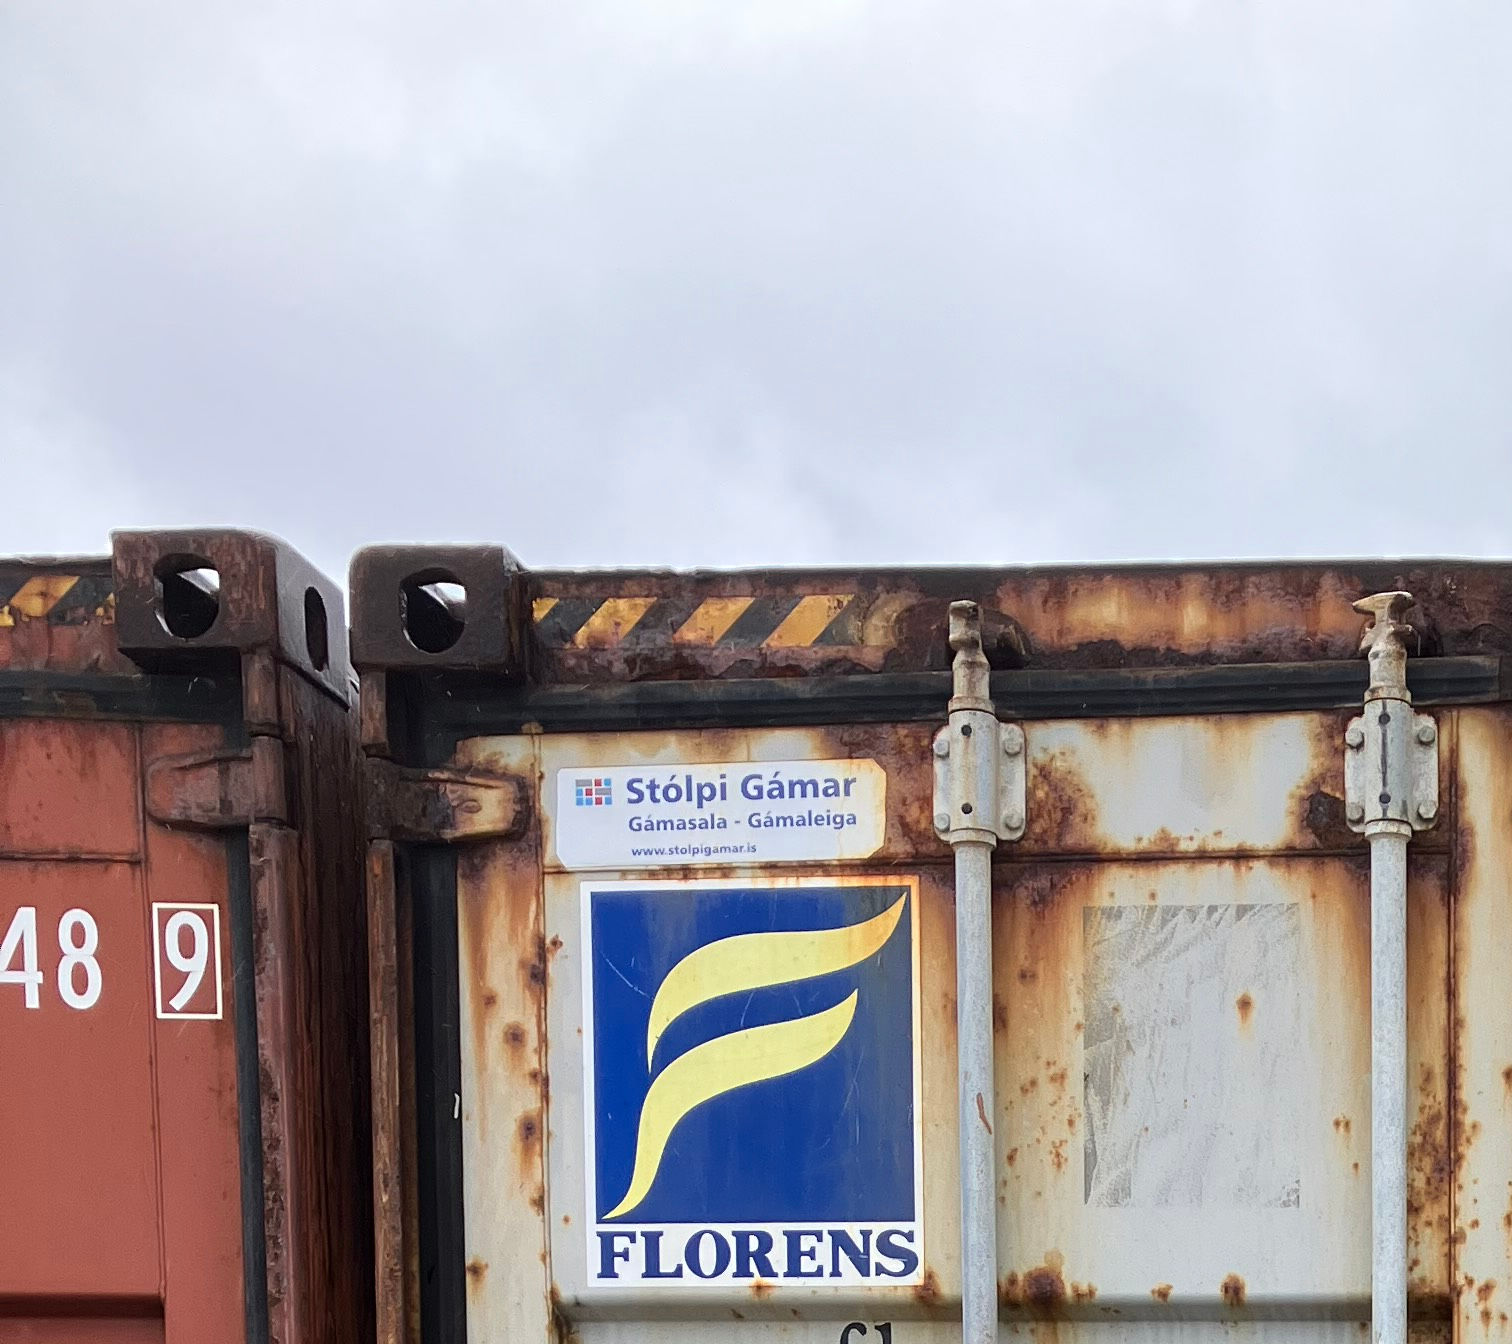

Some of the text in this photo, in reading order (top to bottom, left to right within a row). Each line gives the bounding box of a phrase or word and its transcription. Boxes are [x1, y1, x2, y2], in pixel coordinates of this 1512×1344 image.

[626, 771, 857, 808] Stólpi Gámar
[628, 814, 727, 832] Gámasala
[748, 810, 857, 830] Gámaleiga
[631, 842, 757, 857] www.stolpigamar.is
[0, 907, 208, 1011] 48 9
[596, 1230, 920, 1279] FLORENS
